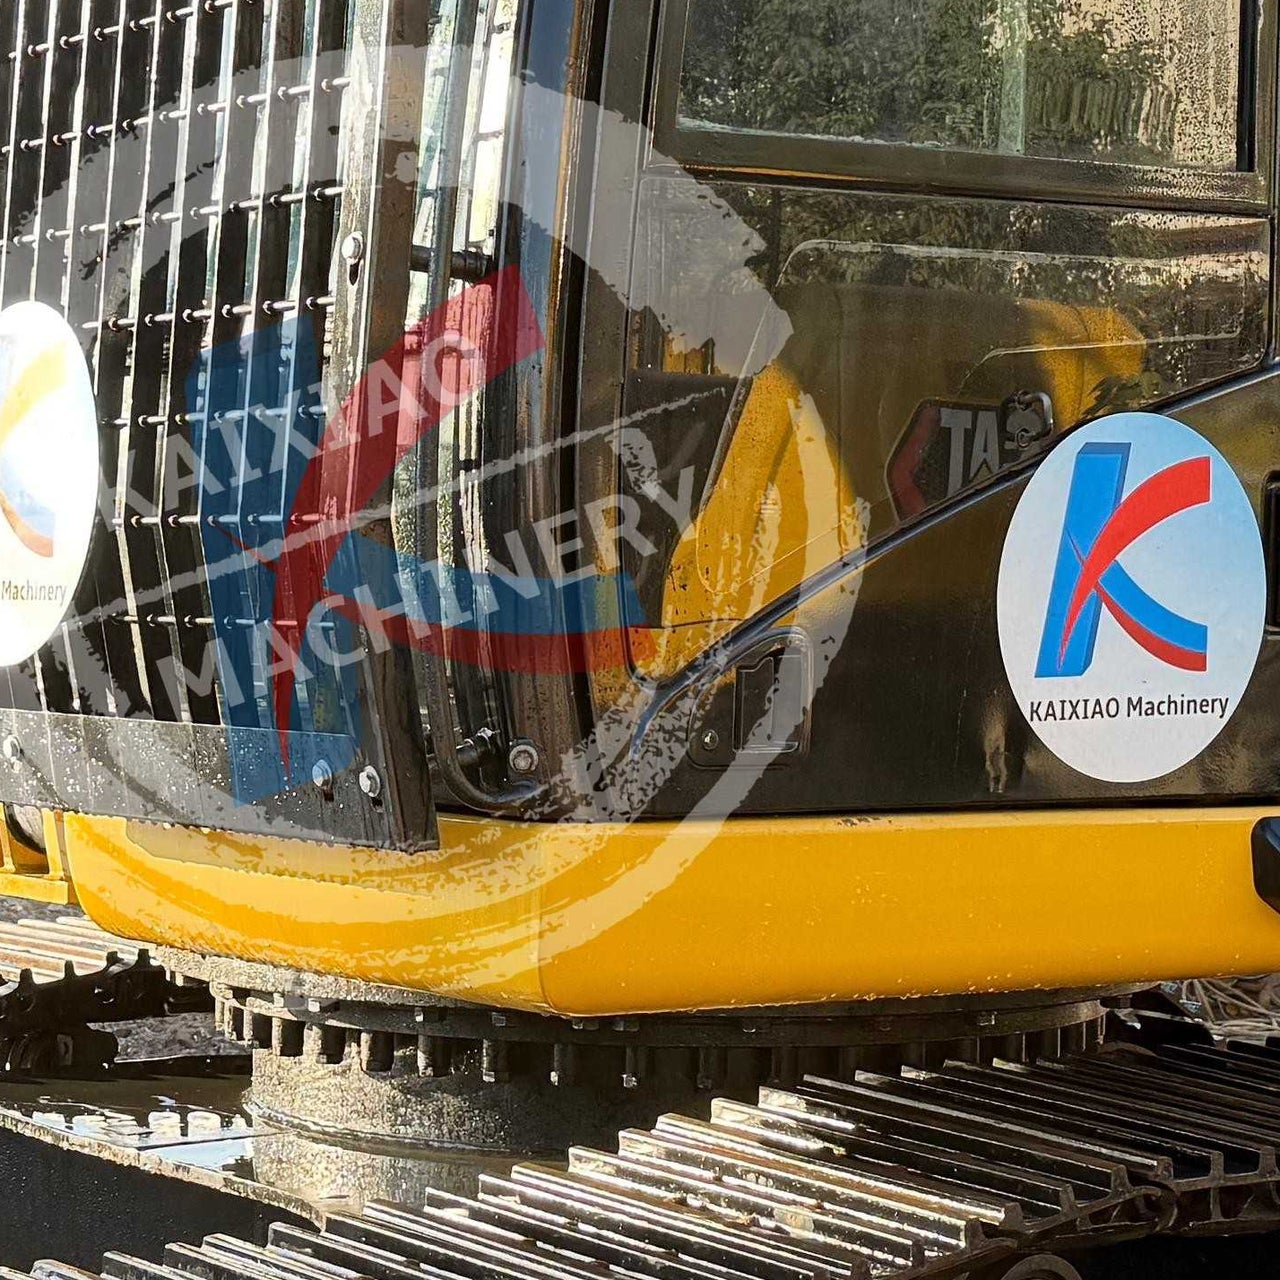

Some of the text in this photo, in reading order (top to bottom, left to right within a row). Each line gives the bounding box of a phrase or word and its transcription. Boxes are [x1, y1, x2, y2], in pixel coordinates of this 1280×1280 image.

[1, 579, 67, 607] Machinery
[1029, 694, 1230, 722] KAIXIAO Machinery
